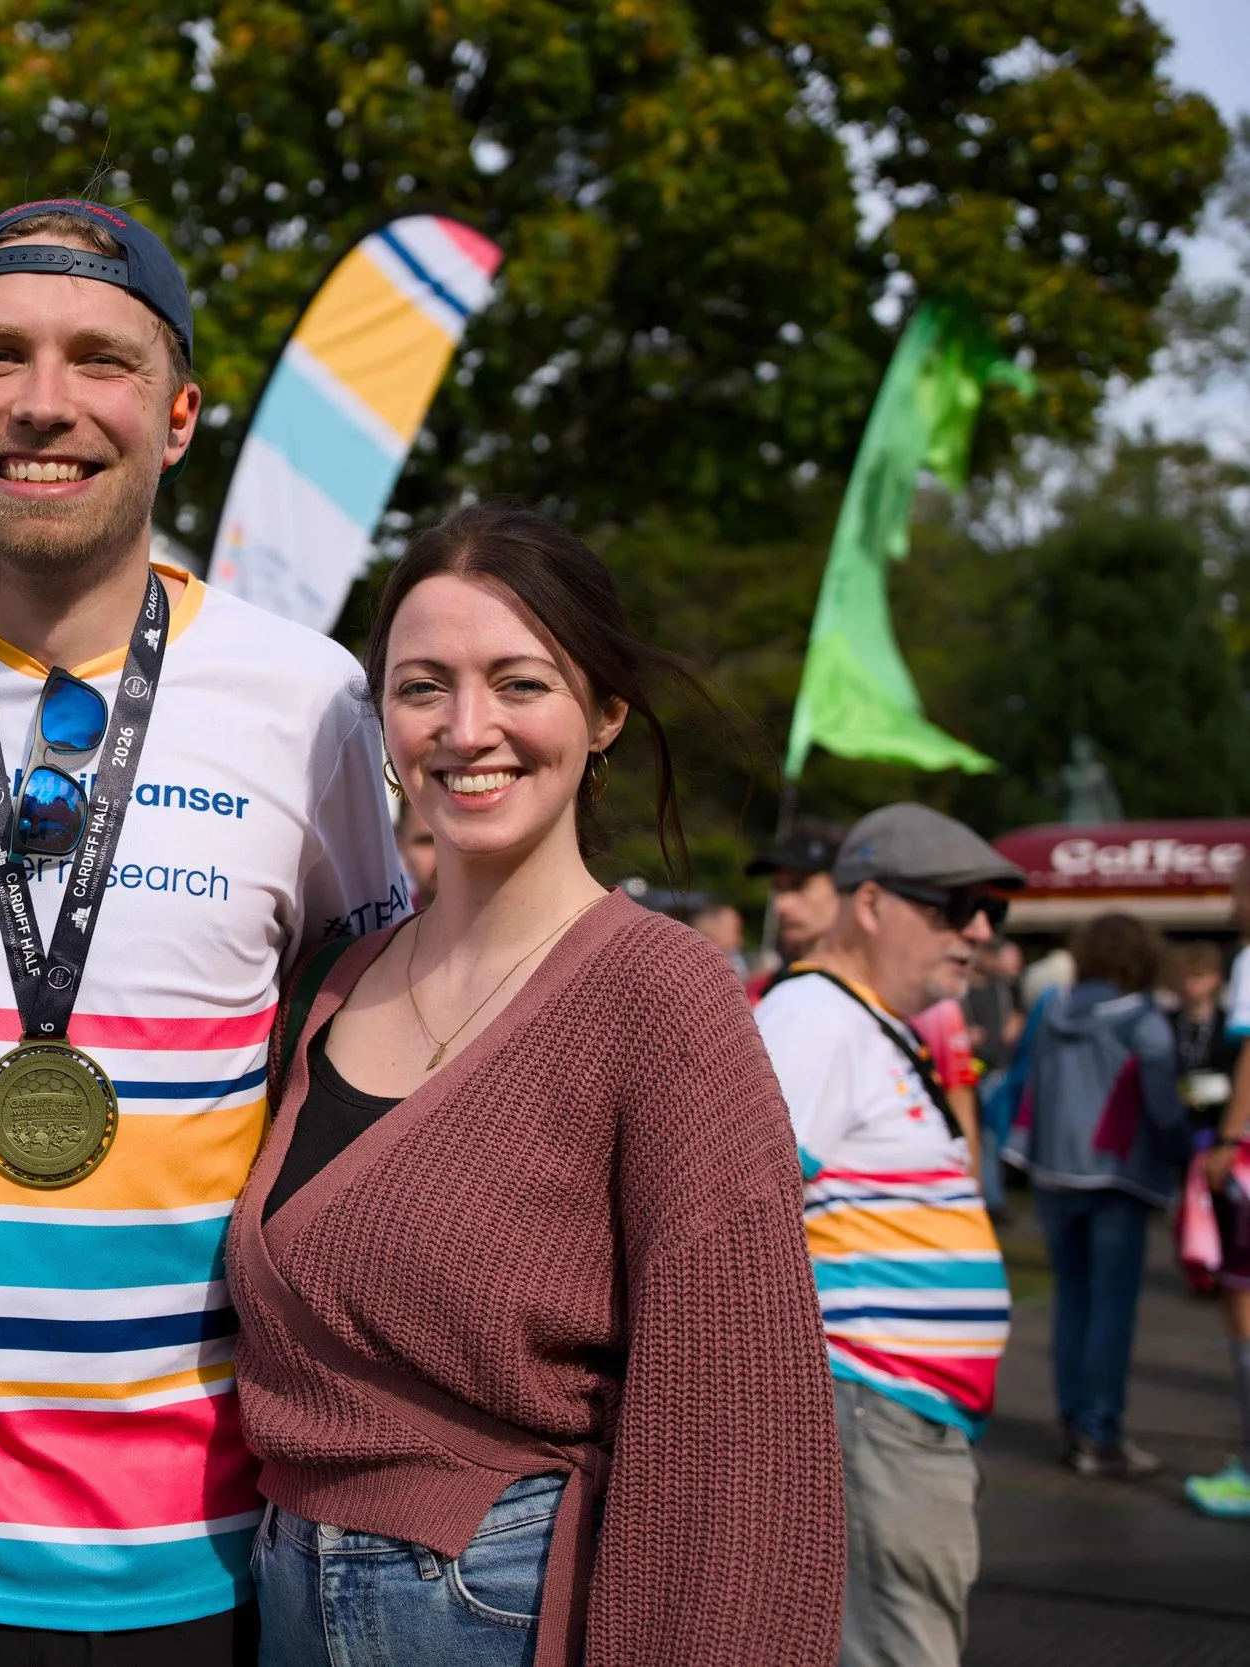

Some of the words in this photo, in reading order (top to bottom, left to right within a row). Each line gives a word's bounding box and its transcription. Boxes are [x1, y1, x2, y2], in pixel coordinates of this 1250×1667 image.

[111, 727, 134, 768] 2026
[127, 783, 250, 819] anser
[73, 835, 100, 897] CARDIFF
[90, 795, 110, 834] HALF
[89, 870, 101, 900] HANNER
[97, 833, 111, 870] MARATHON
[58, 859, 229, 901] rsearch
[2, 905, 16, 944] MARATHON
[6, 872, 31, 934] CARDIFF
[20, 937, 41, 977] HALF
